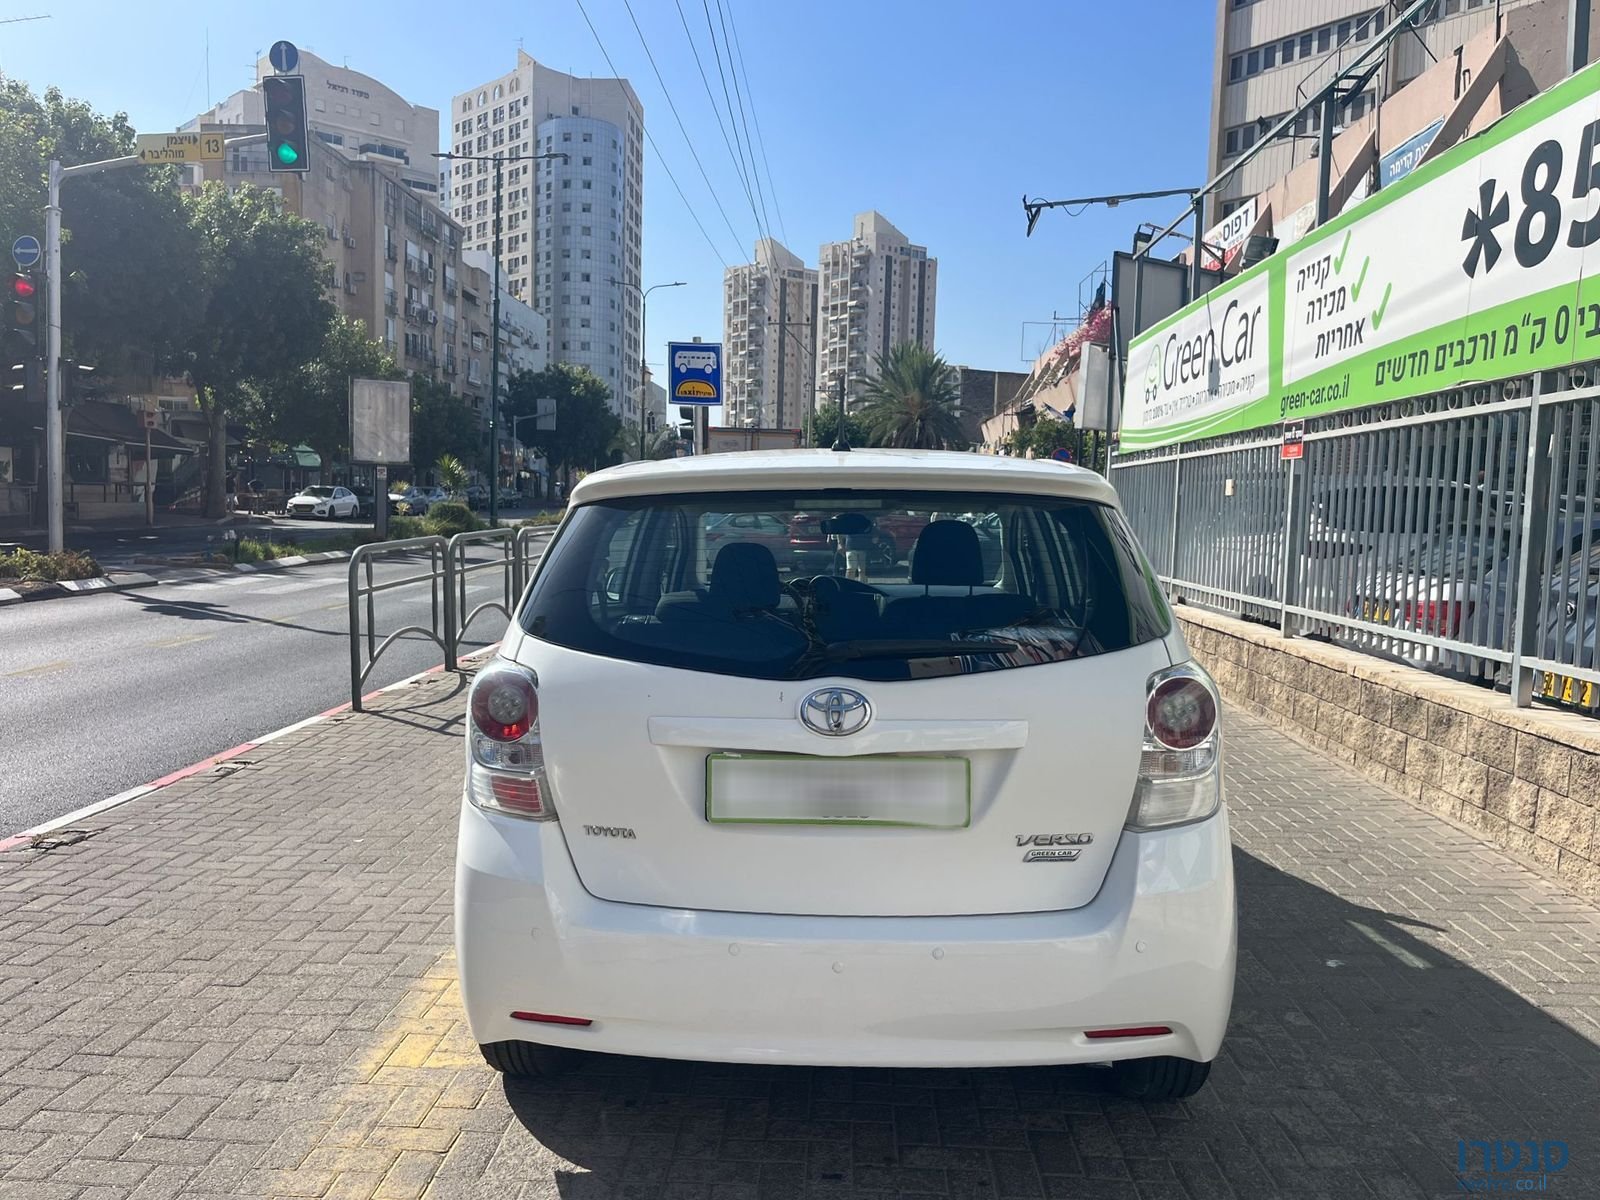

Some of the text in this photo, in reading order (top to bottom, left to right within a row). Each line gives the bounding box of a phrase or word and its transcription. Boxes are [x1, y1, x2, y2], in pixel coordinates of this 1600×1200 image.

[148, 146, 185, 159] מוהליבר
[166, 135, 191, 148] ויצמן
[205, 139, 220, 153] 13
[1389, 151, 1413, 177] קדימה
[1223, 208, 1250, 241] דפוס
[1296, 254, 1332, 293] קנייה
[1306, 285, 1347, 325] מכירה
[1315, 317, 1366, 359] אחריות
[1554, 305, 1570, 345] 0
[1163, 299, 1262, 391] Green Car
[1433, 330, 1497, 372] ורכבים
[1375, 349, 1429, 386] חדשים
[1280, 373, 1350, 418] green-car.co.il
[582, 824, 637, 839] TOYOTA
[1015, 832, 1094, 847] VERSO
